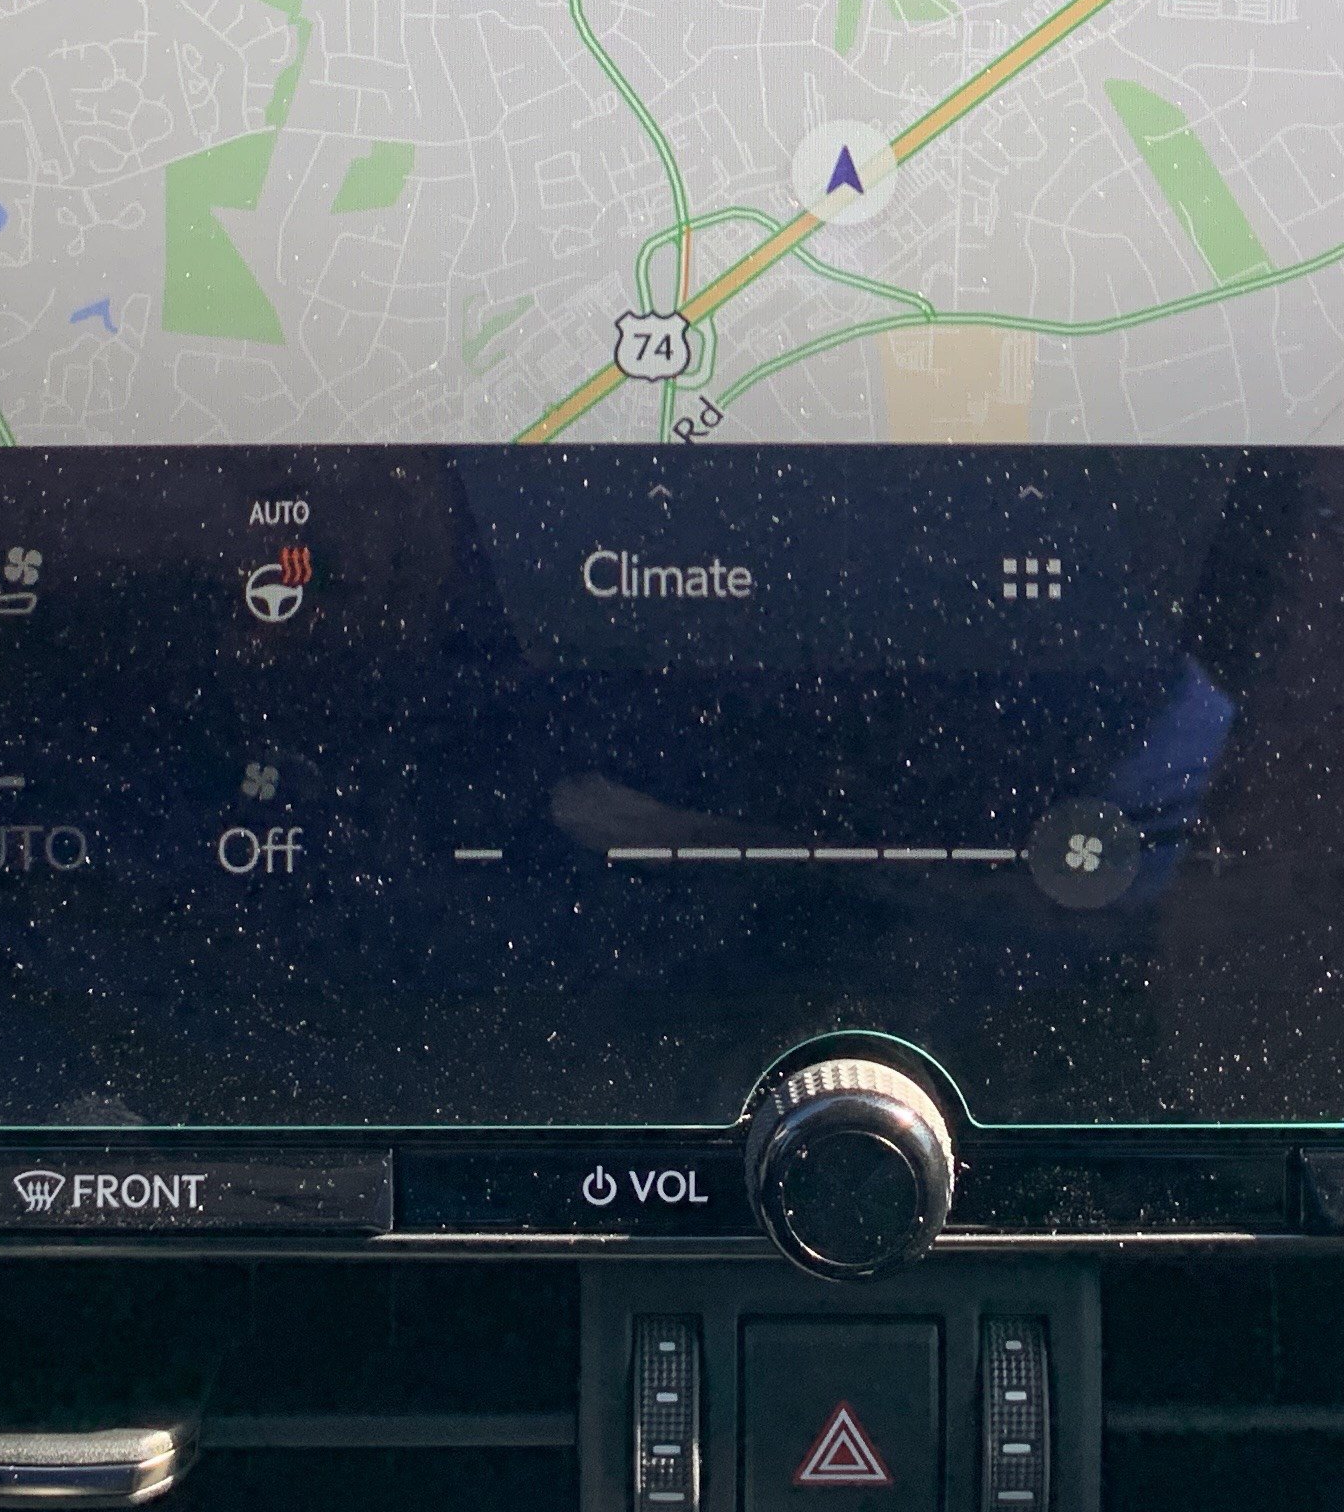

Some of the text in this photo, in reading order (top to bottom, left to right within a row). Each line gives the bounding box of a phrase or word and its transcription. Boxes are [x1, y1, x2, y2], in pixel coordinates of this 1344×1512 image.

[633, 334, 674, 361] 74
[249, 500, 309, 525] AUTO
[583, 550, 752, 598] Climate
[217, 828, 304, 874] Off
[72, 1173, 205, 1209] FRONT
[629, 1170, 708, 1203] VOL
